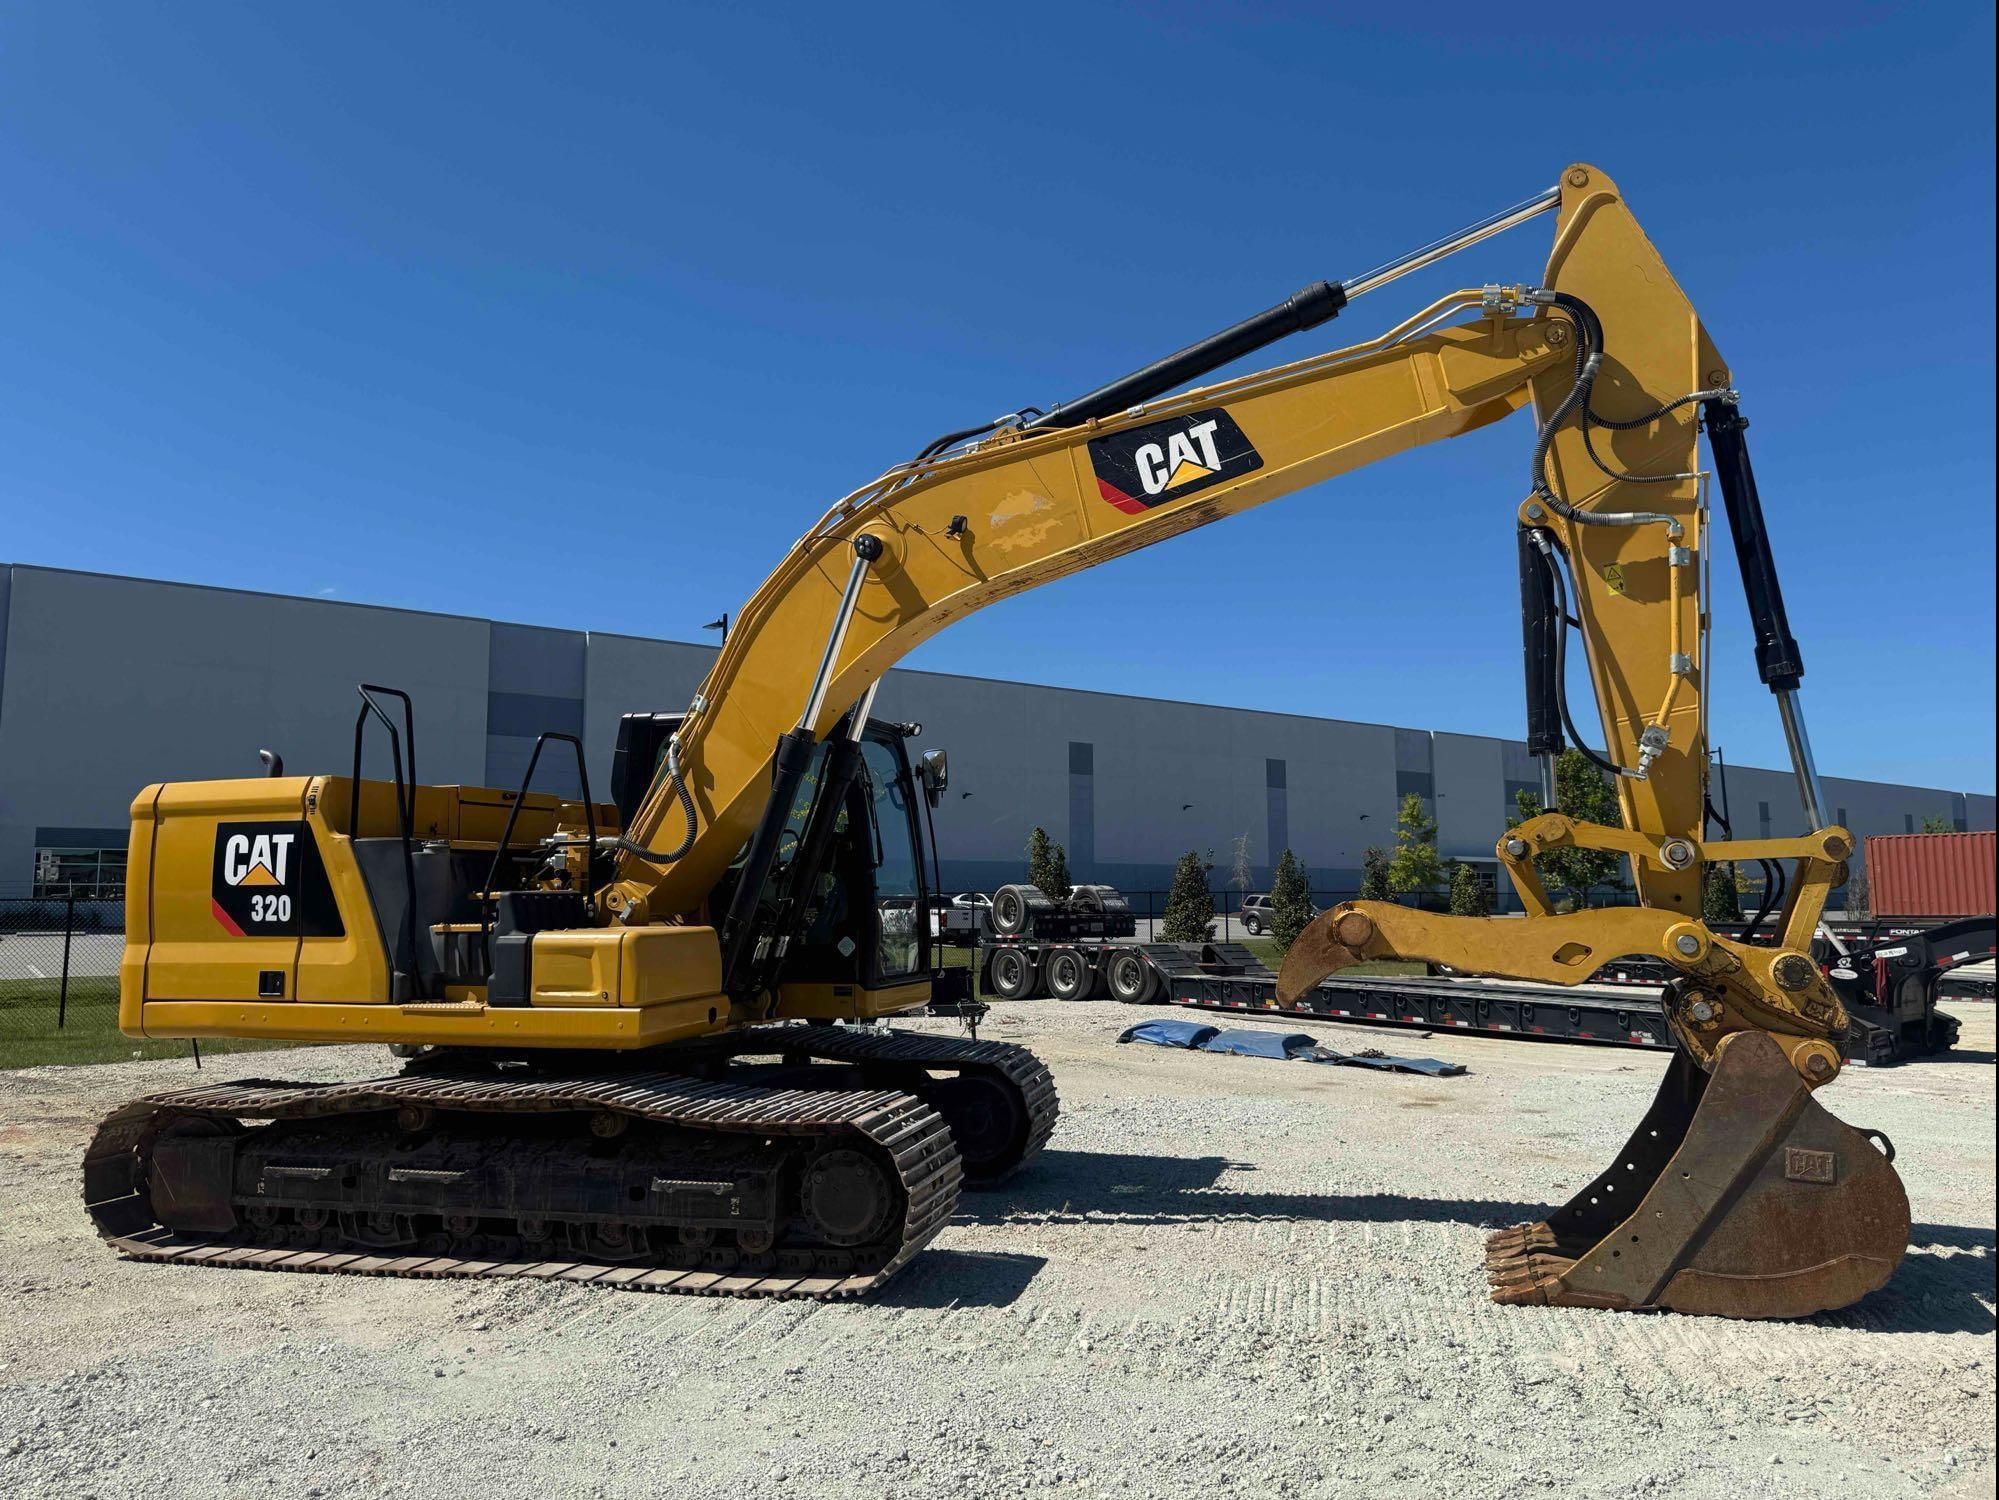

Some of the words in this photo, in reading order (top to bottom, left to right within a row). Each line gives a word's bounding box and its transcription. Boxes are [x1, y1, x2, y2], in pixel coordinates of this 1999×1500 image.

[1134, 419, 1221, 495] CAT
[224, 833, 294, 886] CAT
[251, 894, 291, 922] 320
